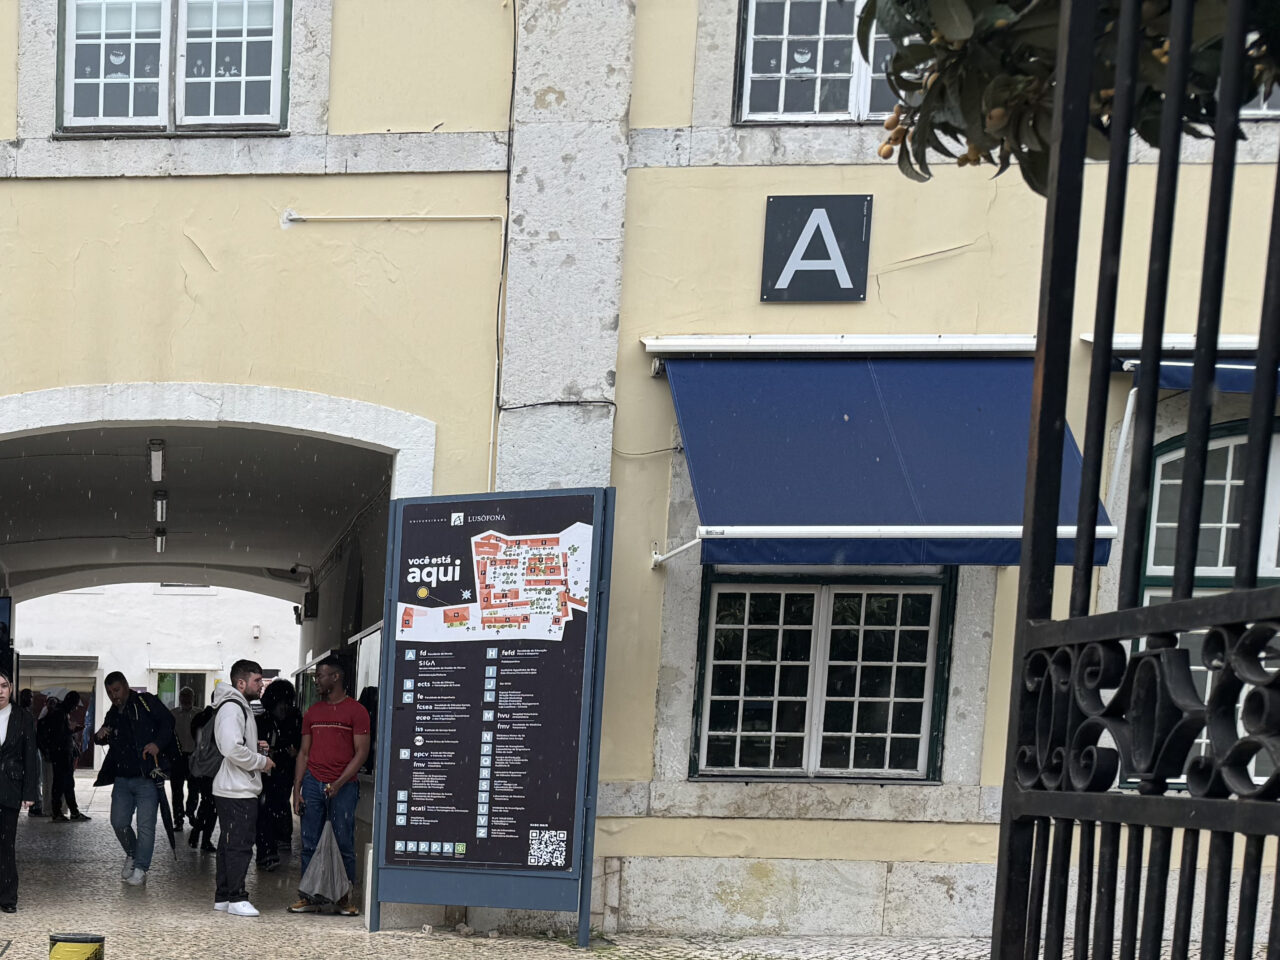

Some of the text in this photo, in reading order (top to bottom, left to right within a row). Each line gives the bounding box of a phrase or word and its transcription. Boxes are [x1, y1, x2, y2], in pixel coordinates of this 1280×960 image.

[774, 208, 854, 289] A
[408, 555, 451, 565] você está
[407, 559, 461, 587] aqui
[407, 651, 414, 659] A
[486, 693, 492, 701] L
[484, 712, 492, 720] M
[484, 745, 489, 753] P
[482, 769, 488, 777] R
[399, 792, 406, 800] E
[481, 793, 487, 801] T
[399, 804, 405, 812] F
[480, 805, 486, 813] U
[479, 817, 486, 825] V
[479, 829, 486, 837] Z
